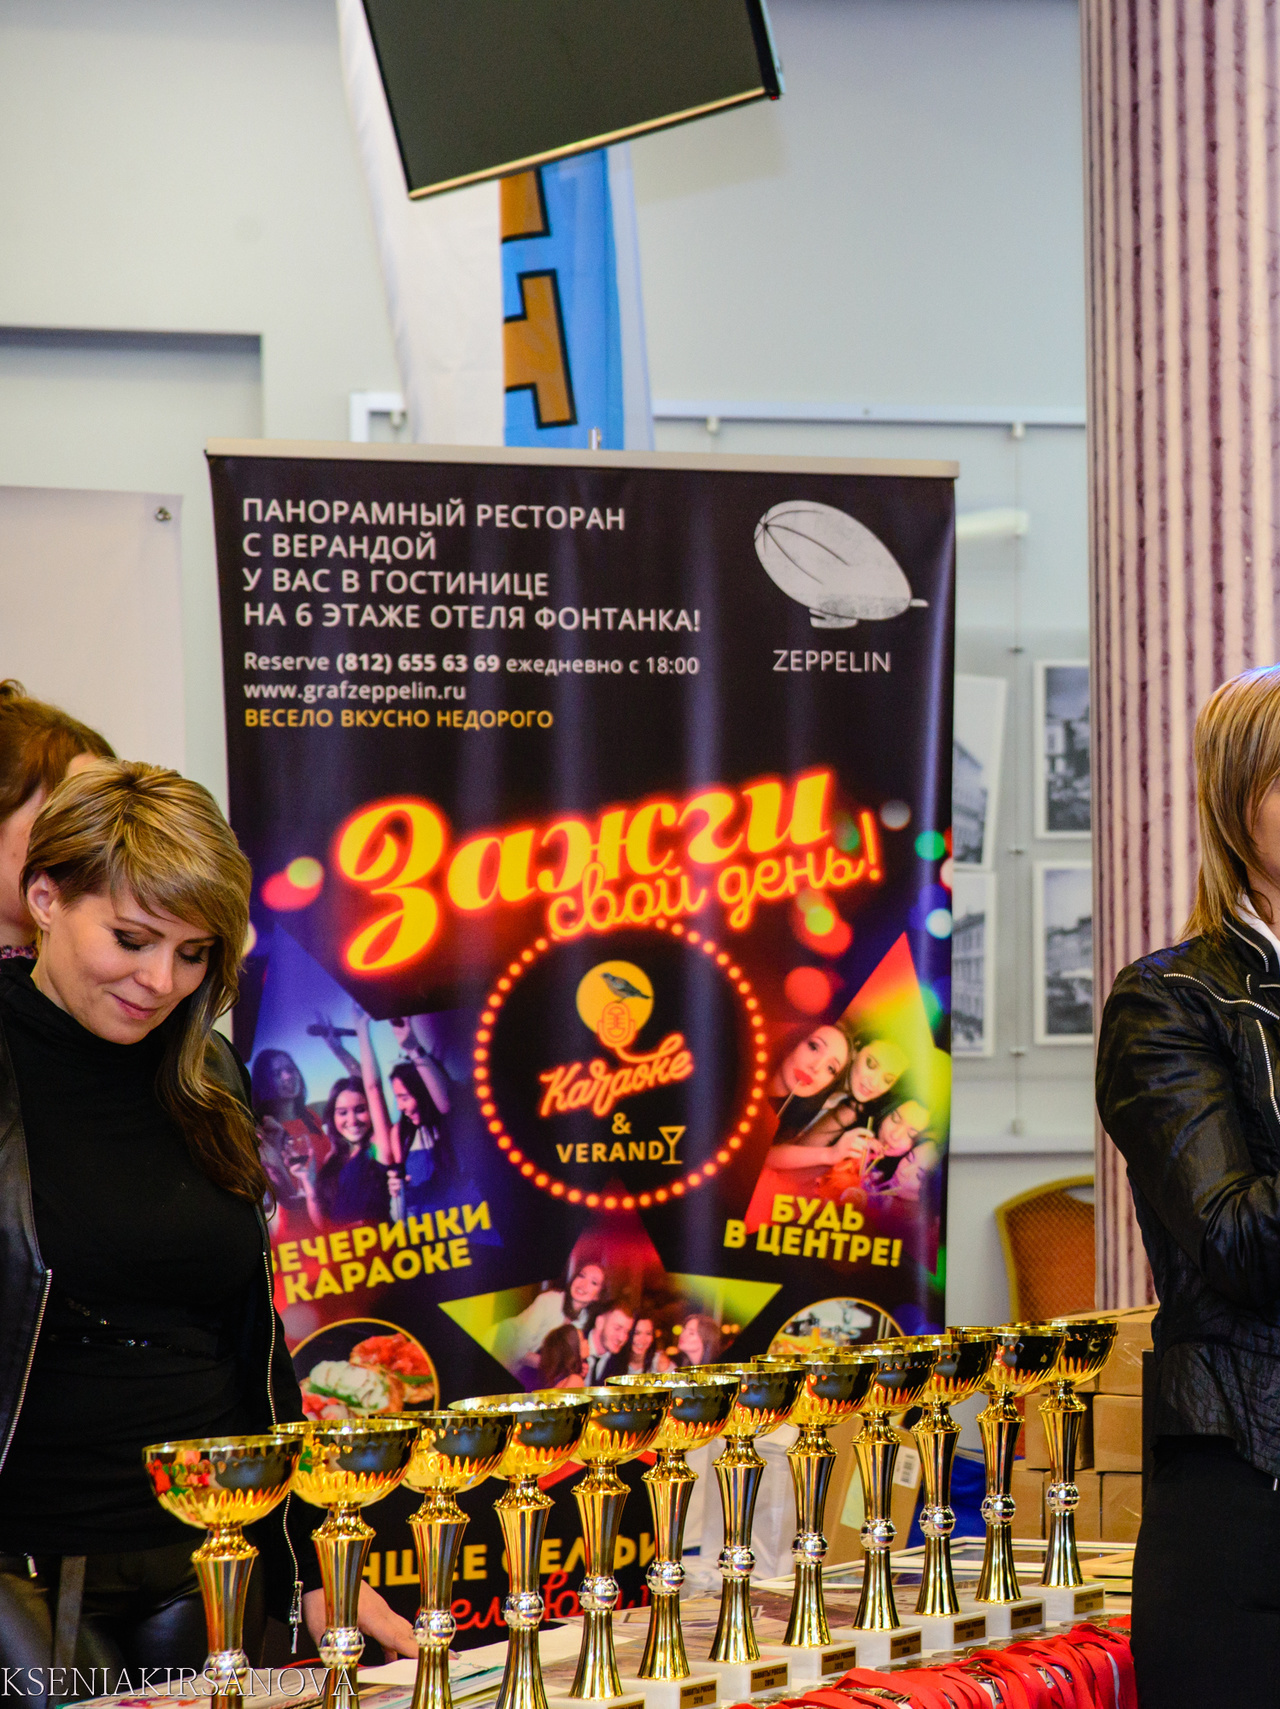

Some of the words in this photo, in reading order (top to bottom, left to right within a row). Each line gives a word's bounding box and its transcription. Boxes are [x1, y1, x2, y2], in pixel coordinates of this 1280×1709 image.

[242, 498, 466, 527] ПАНОРАМНЫЙ
[476, 504, 625, 531] РЕСТОРАН
[242, 532, 262, 558] С
[272, 531, 437, 565] ВЕРАНДОЙ
[242, 567, 262, 592] У
[272, 568, 331, 593] ВАС
[341, 569, 361, 593] В
[371, 570, 549, 601] ГОСТИНИЦЕ
[244, 602, 287, 626] НА
[295, 602, 313, 627] 6
[322, 603, 421, 628] ЭТАЖЕ
[430, 604, 526, 629] ОТЕЛЯ
[534, 605, 701, 632] ФОНТАНКА!
[243, 651, 330, 671] Reserve
[336, 652, 393, 675] (812)
[397, 653, 437, 672] 655
[441, 653, 469, 672] 63
[473, 654, 501, 672] 69
[505, 657, 624, 677] ежедневно
[629, 659, 640, 674] с
[645, 656, 700, 675] 18:00
[772, 649, 891, 673] ZEPPELIN
[243, 680, 467, 704] www.grafzeppelin.ru
[244, 708, 334, 728] ВЕСЕЛО
[340, 709, 431, 729] ВКУСНО
[436, 709, 554, 732] НЕДОРОГО
[338, 771, 832, 975] Зажги
[546, 860, 708, 939] свой
[717, 810, 883, 929] день!
[611, 1111, 632, 1135] &
[771, 1193, 865, 1233] БУДЬ
[271, 1201, 492, 1273] ЕЧЕРИНКИ
[723, 1218, 747, 1249] В
[756, 1223, 903, 1268] ЦЕНТРЕ!
[283, 1237, 473, 1305] КАРАОКЕ
